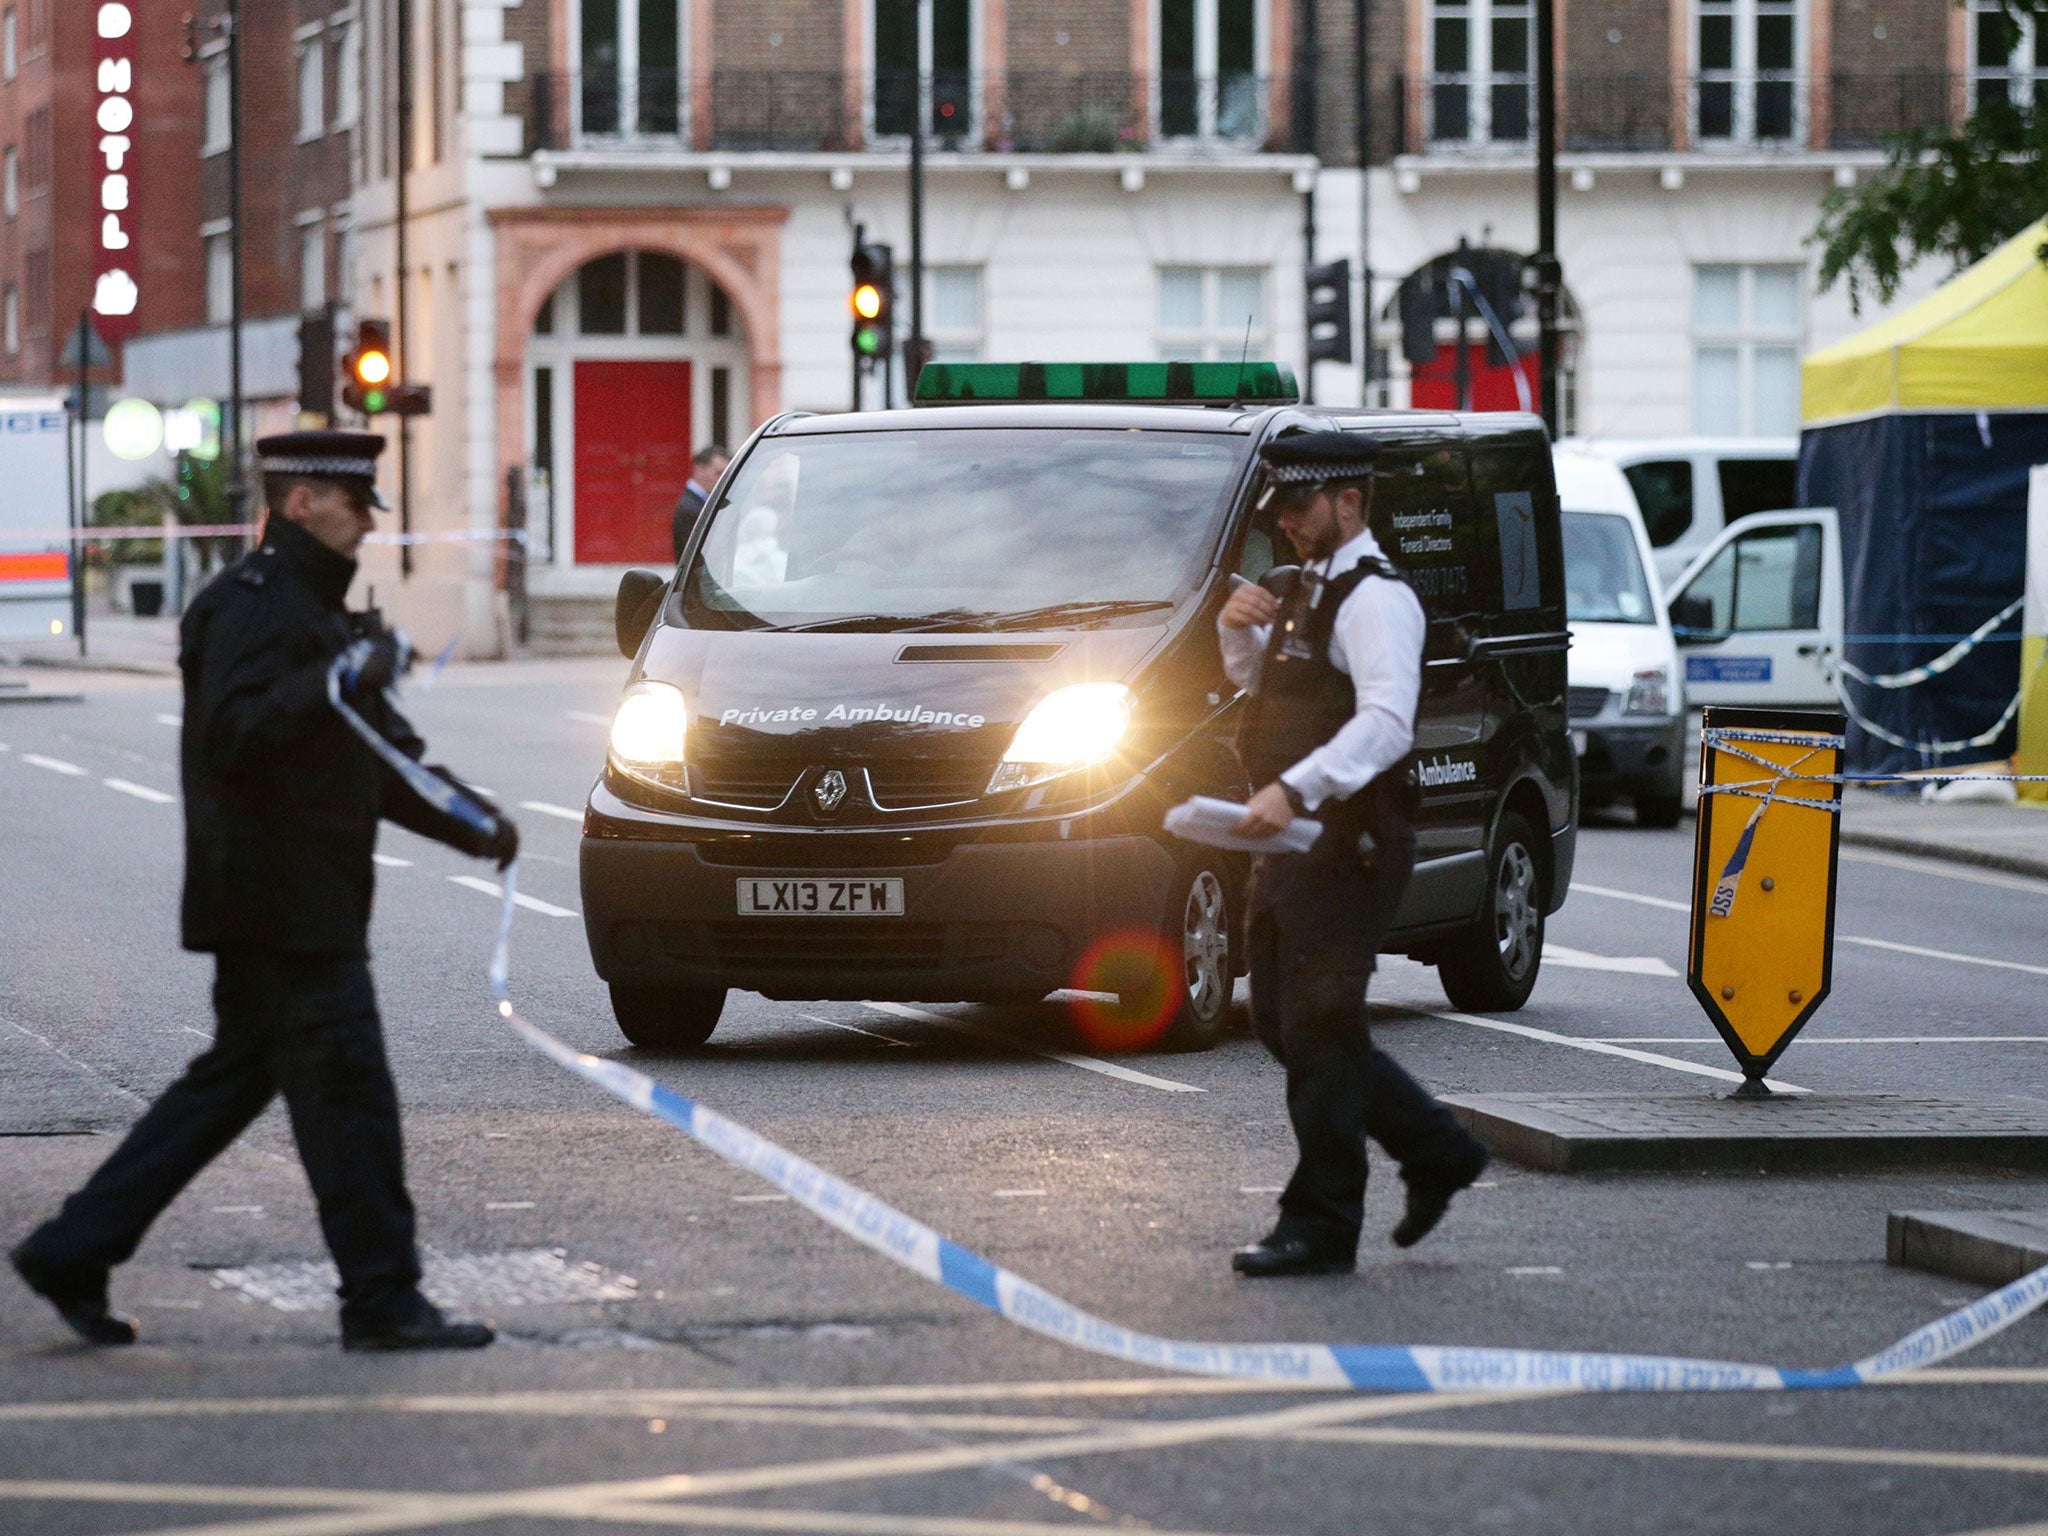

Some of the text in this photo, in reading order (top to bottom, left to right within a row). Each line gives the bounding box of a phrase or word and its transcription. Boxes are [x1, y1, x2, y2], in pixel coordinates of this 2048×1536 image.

[97, 57, 133, 249] HOTEL
[1400, 535, 1423, 553] Funeral
[719, 704, 986, 728] Private Ambulance
[1418, 754, 1476, 787] Ambulance
[752, 882, 888, 911] LX13 ZFW
